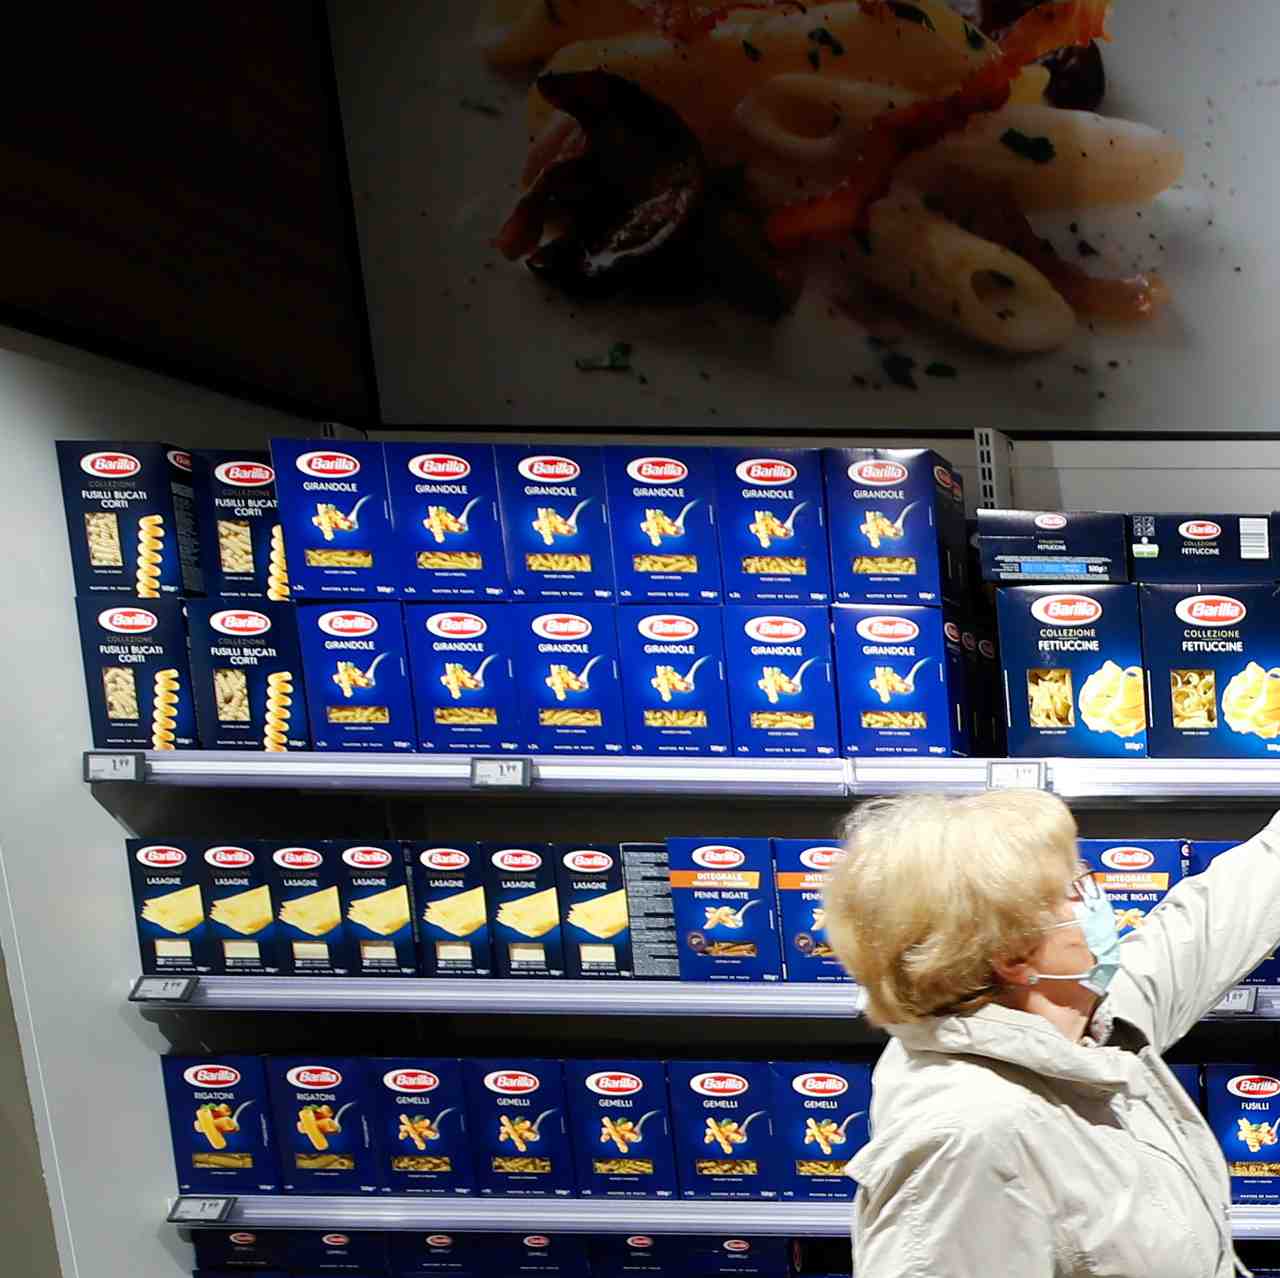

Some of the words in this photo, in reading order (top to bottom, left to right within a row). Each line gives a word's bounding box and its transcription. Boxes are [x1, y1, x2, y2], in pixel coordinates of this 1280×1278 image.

[94, 458, 136, 473] Barilla
[311, 457, 355, 473] Barilla
[859, 465, 902, 479] Barilla
[303, 481, 357, 493] GIRANDOLE
[81, 490, 111, 500] FUSILLI
[113, 490, 147, 500] BUCATI
[853, 489, 905, 500] GIRANDOLE
[100, 499, 129, 508] CORTI
[1181, 547, 1220, 556] FETTUCCINE
[1048, 602, 1097, 617] Barilla
[1040, 628, 1096, 638] COLLEZIONE
[750, 645, 803, 657] GIRANDOLE
[1038, 640, 1099, 652] FETTUCCINE
[151, 851, 184, 863] Barilla
[287, 851, 320, 863] Barilla
[435, 854, 467, 866] Barilla
[709, 851, 741, 863] Barilla
[146, 877, 182, 887] LASAGNE
[284, 878, 319, 888] LASAGNE
[430, 879, 464, 889] LASAGNE
[694, 890, 718, 900] PENNE
[721, 890, 749, 901] RIGATE
[197, 1070, 236, 1083] Barilla
[499, 1076, 537, 1089] Barilla
[1239, 1081, 1278, 1093] Barilla
[194, 1091, 234, 1101] RIGATONI
[496, 1097, 530, 1107] GEMELLI
[1241, 1102, 1270, 1111] FUSILLI
